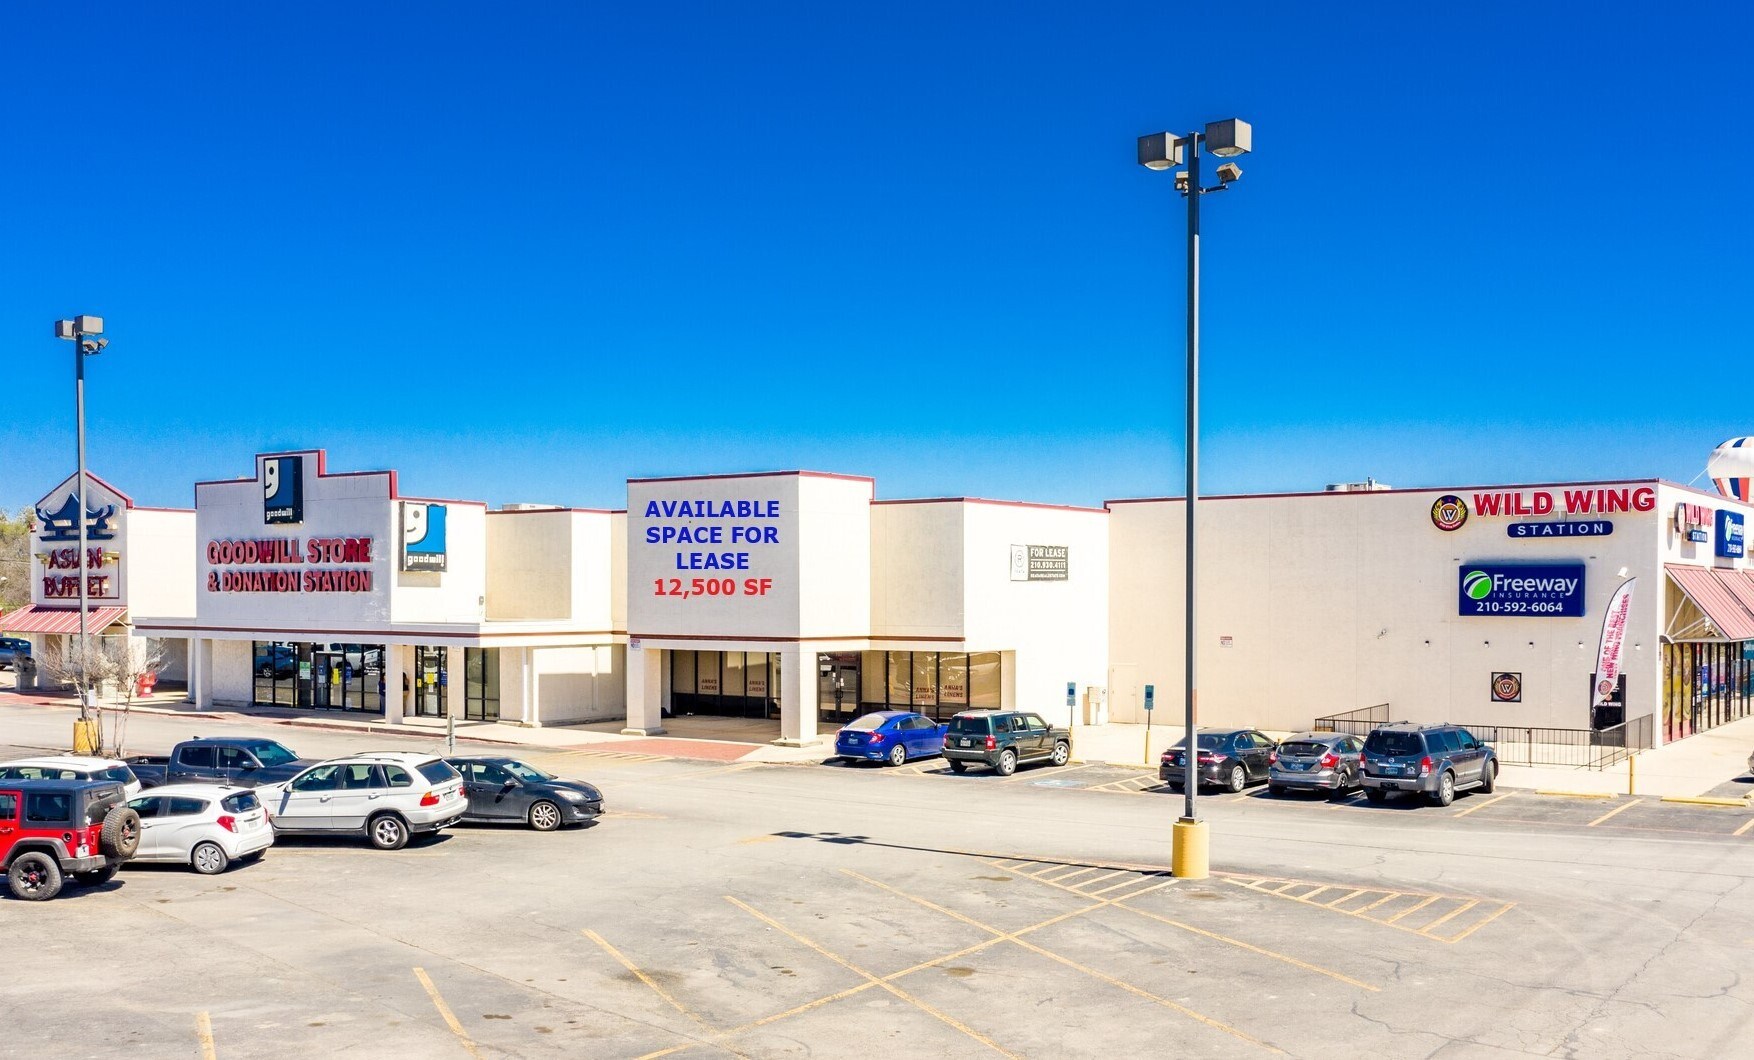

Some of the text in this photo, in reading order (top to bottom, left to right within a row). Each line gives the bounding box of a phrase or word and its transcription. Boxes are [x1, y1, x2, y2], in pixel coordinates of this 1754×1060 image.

[1473, 487, 1656, 516] WILD WING
[266, 508, 293, 521] goodwill
[1517, 523, 1604, 535] STATION
[206, 538, 373, 565] GOODWILL STORE
[1031, 548, 1066, 558] FOR LEASE
[407, 553, 445, 568] goodwill
[207, 571, 373, 592] & DONATION STATION
[1493, 574, 1577, 595] Freeway
[1476, 602, 1563, 612] 210-592-6064
[1606, 662, 1614, 679] NEW
